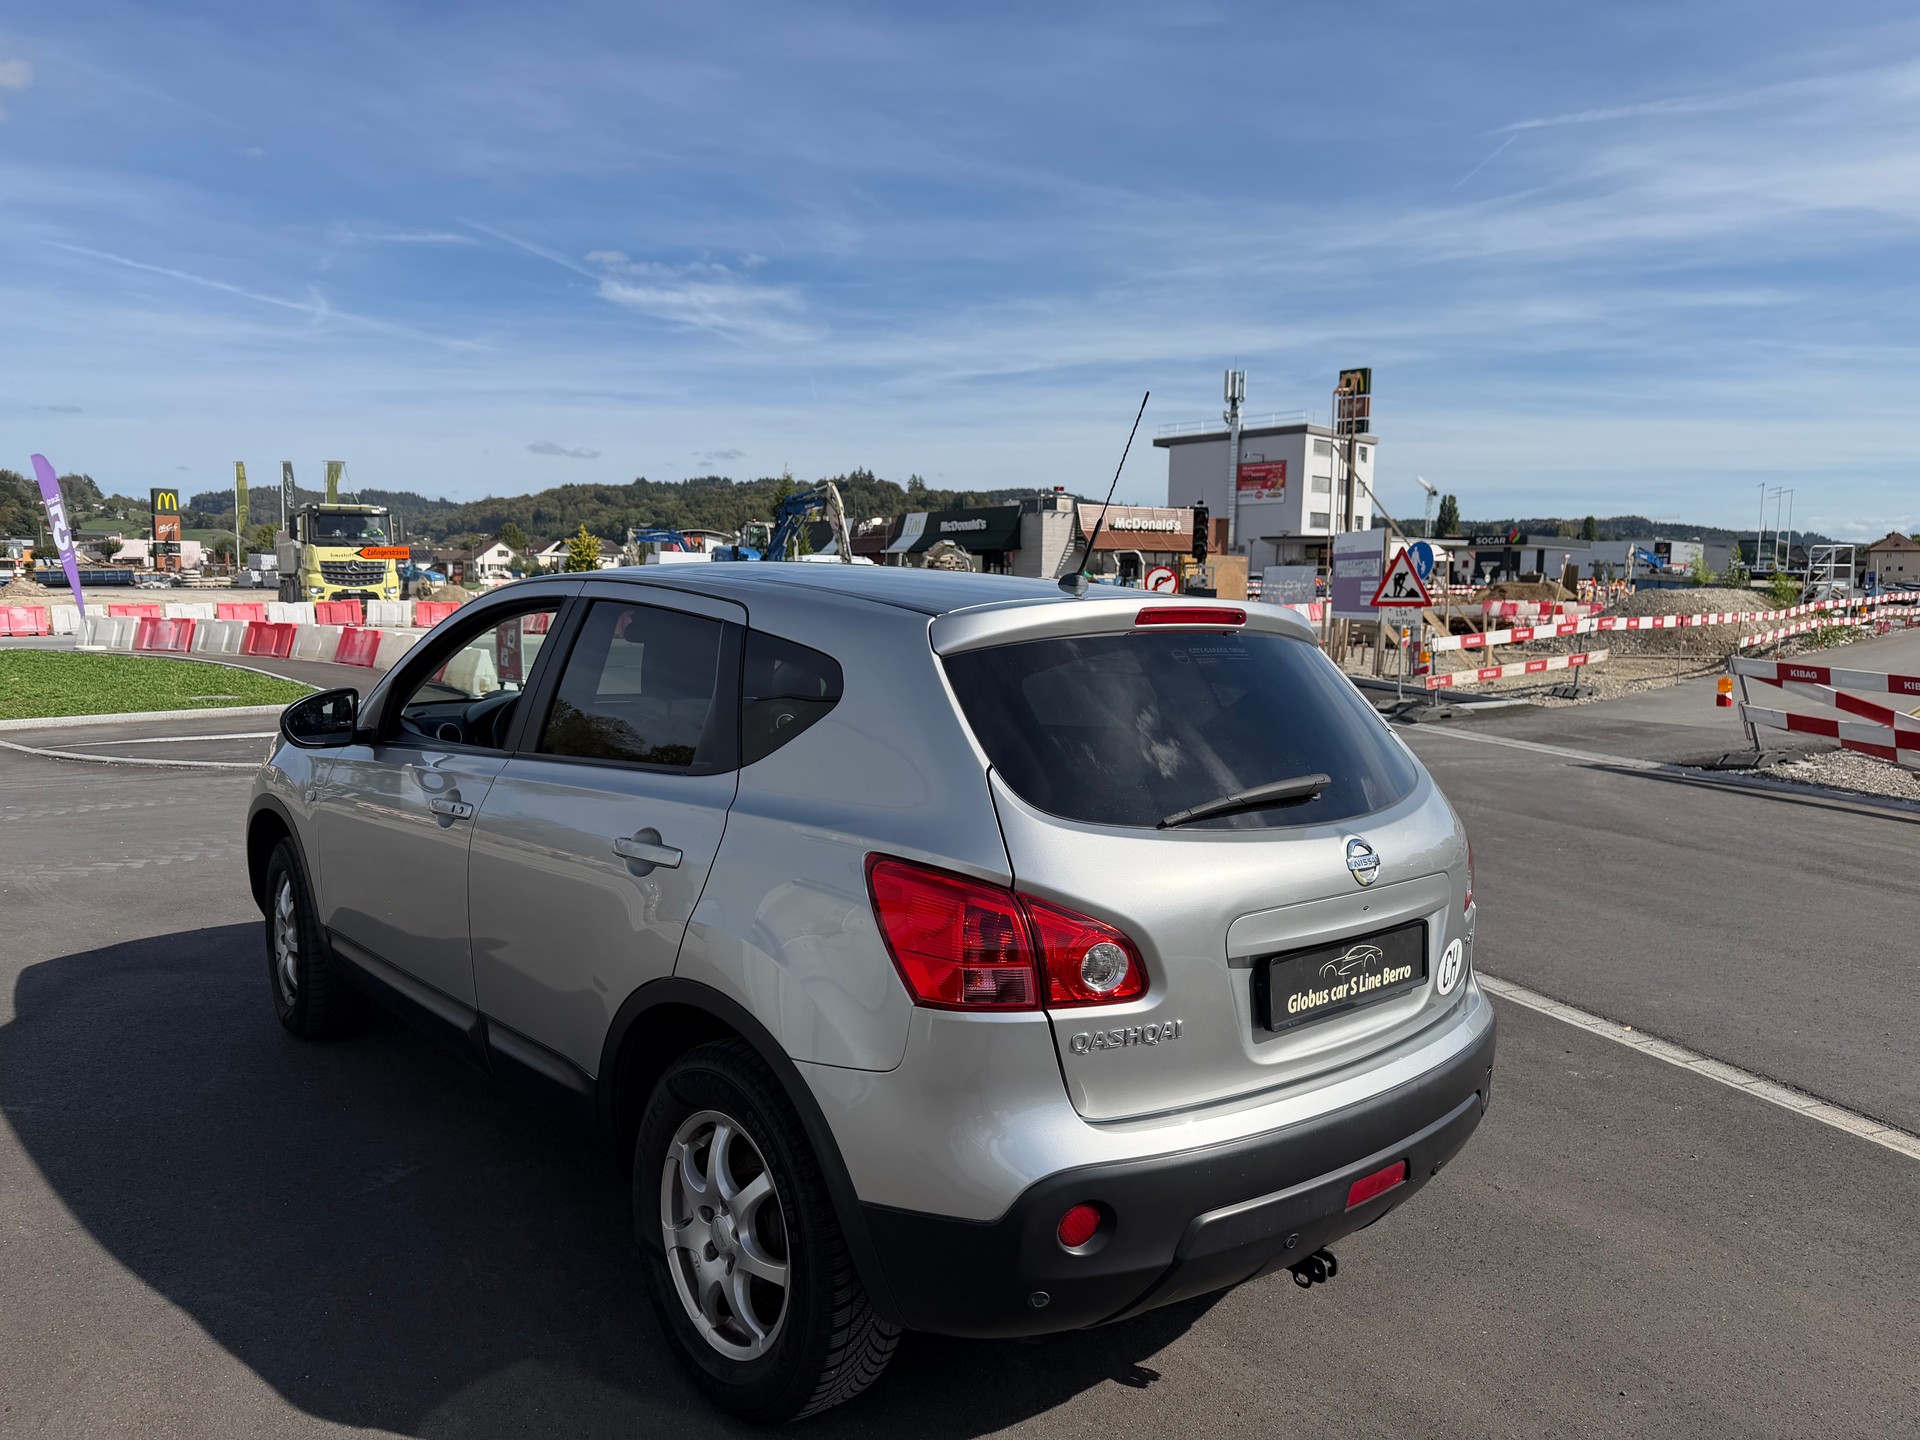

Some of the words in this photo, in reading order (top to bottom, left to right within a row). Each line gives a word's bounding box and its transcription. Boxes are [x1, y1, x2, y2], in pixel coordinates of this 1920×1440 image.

[940, 519, 987, 532] McDonald's
[1114, 517, 1182, 531] McDonald's
[1476, 536, 1506, 545] SOCAR
[367, 549, 408, 557] Zofingerstrasse
[1396, 608, 1407, 617] LSA
[1790, 669, 1818, 680] KIBAG
[1443, 944, 1459, 988] CH
[1287, 988, 1329, 1013] Globus
[1330, 982, 1349, 1001] car
[1350, 977, 1358, 996] S
[1359, 972, 1381, 993] Line
[1383, 965, 1411, 986] Berro
[1070, 1019, 1183, 1054] QASHQAI
